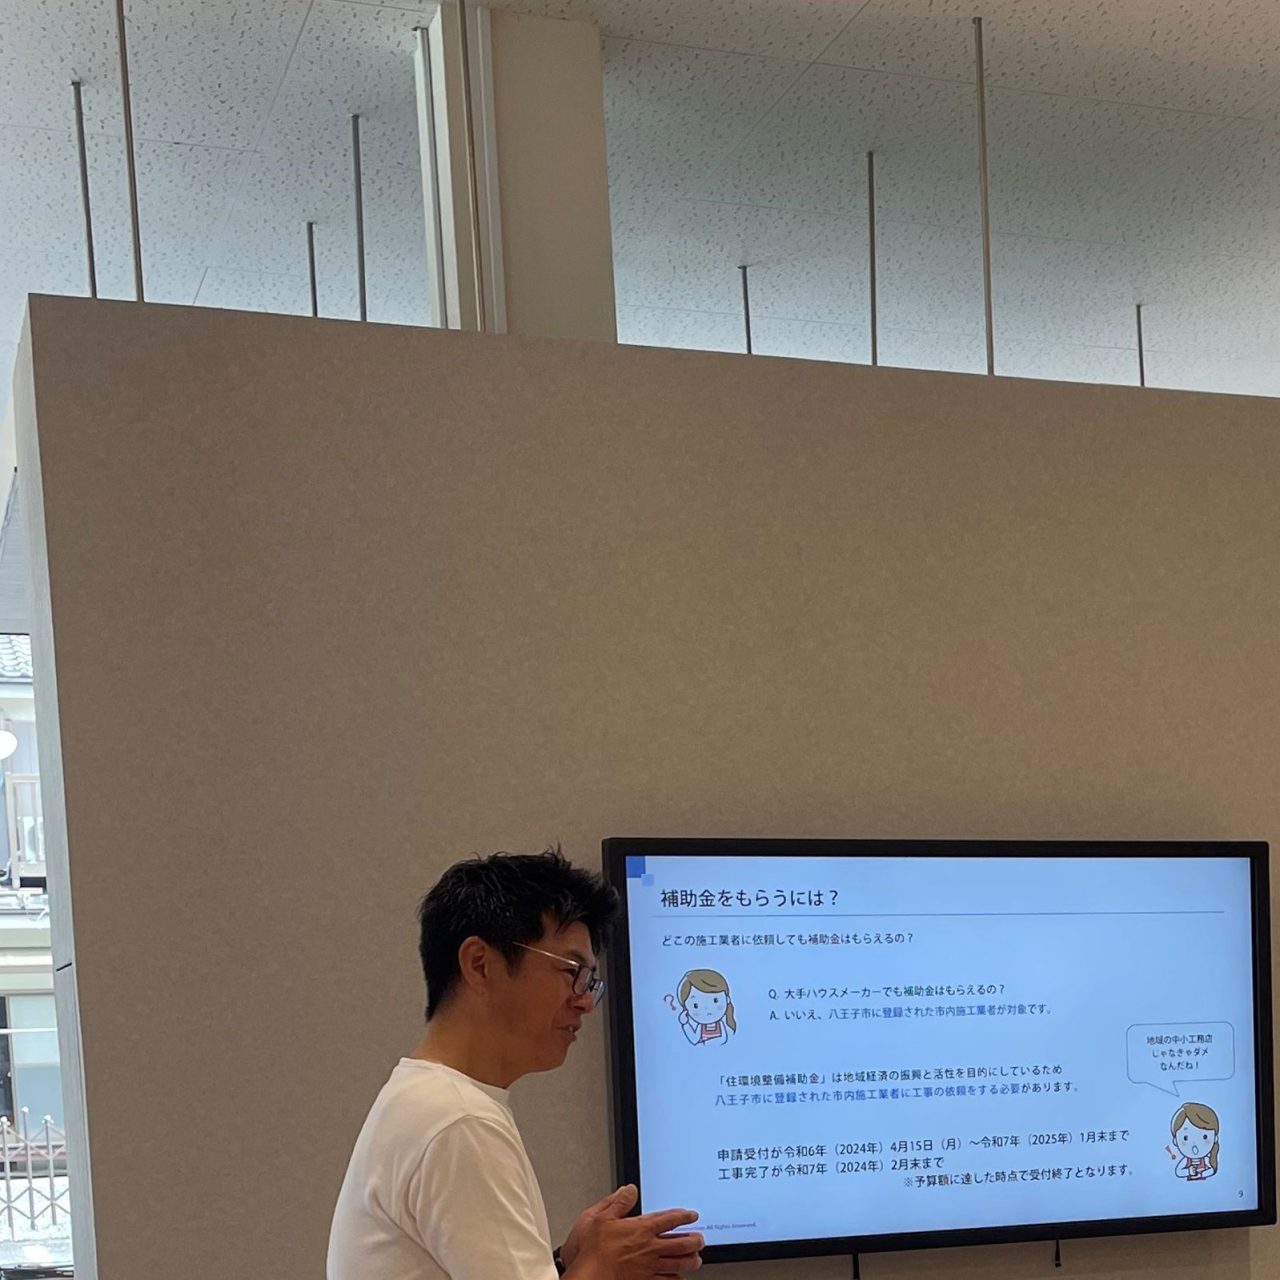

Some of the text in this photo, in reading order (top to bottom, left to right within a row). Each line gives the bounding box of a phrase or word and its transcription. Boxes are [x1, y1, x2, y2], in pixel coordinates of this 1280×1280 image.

[660, 889, 838, 908] 補助金をもらうには？
[661, 932, 914, 947] どこの施工業者に依頼しても補助金はもらえるの？
